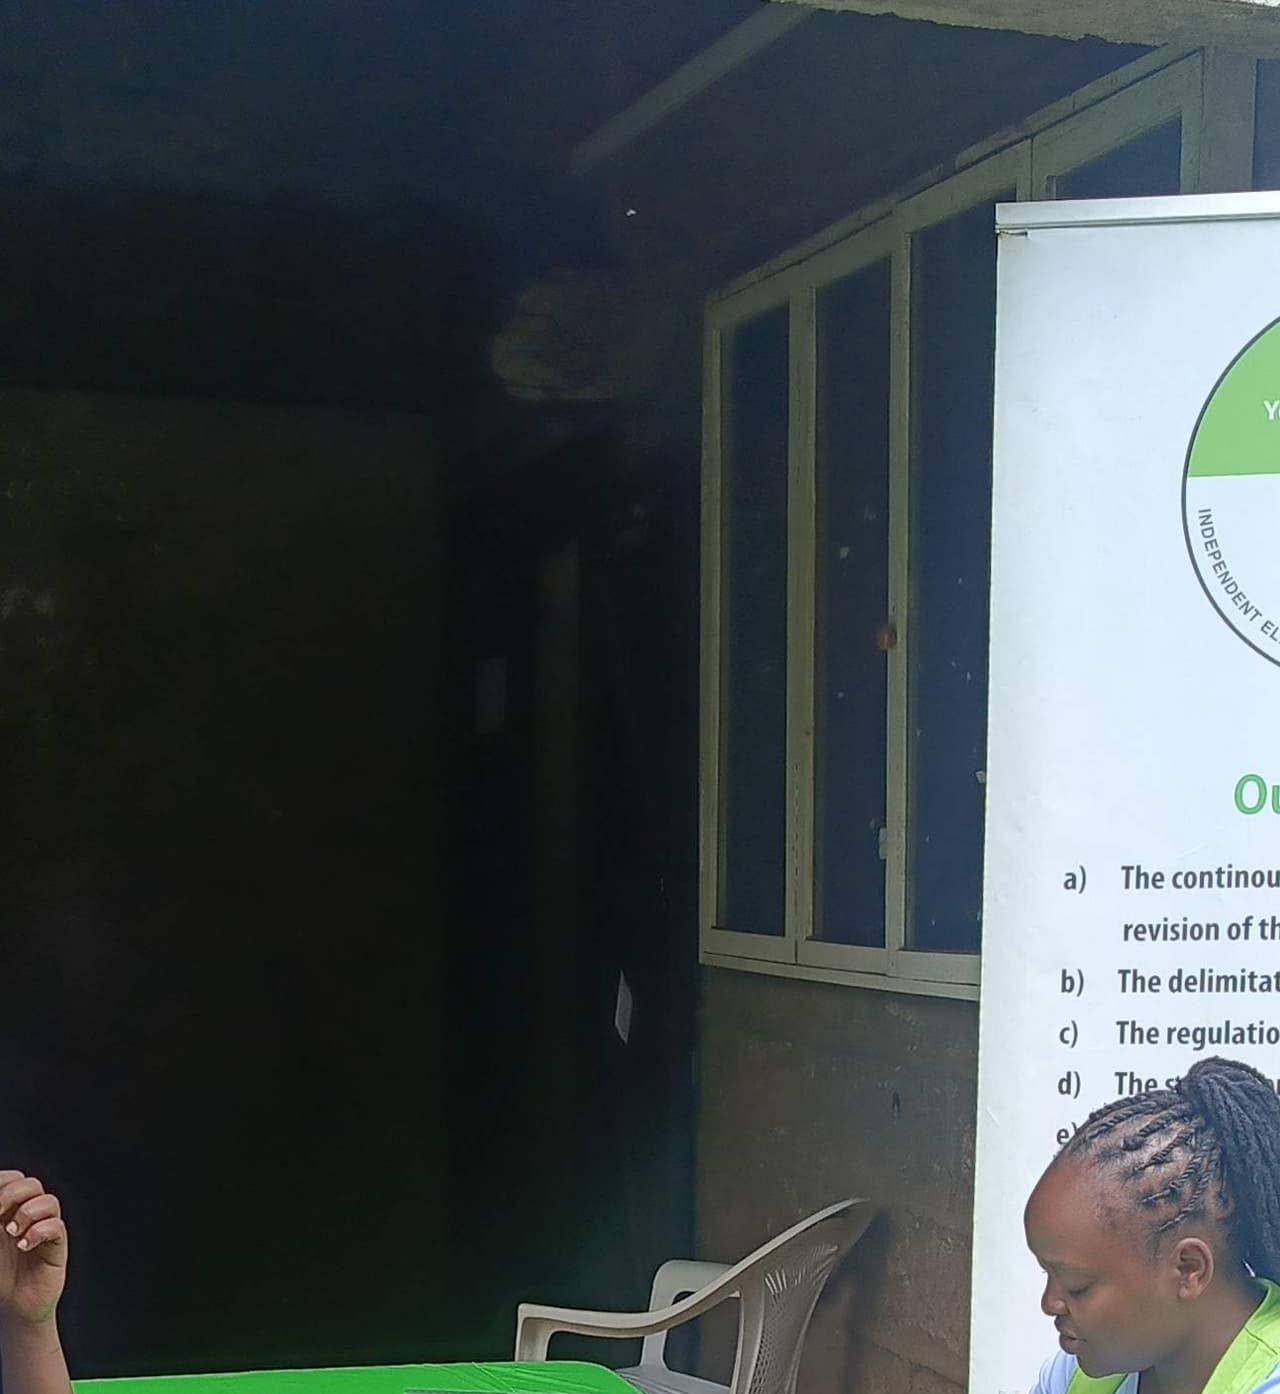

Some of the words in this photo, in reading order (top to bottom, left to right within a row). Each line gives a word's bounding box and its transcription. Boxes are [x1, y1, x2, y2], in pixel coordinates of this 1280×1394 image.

[1197, 508, 1263, 623] INDEPENDENT
[1063, 864, 1087, 894] a)
[1120, 864, 1166, 891] The
[1122, 916, 1220, 943] revision
[1226, 915, 1256, 942] of
[1060, 967, 1085, 998] b)
[1117, 967, 1162, 994] The
[1058, 1019, 1080, 1049] c)
[1115, 1019, 1160, 1046] The
[1057, 1071, 1082, 1099] d)
[1114, 1071, 1159, 1096] The
